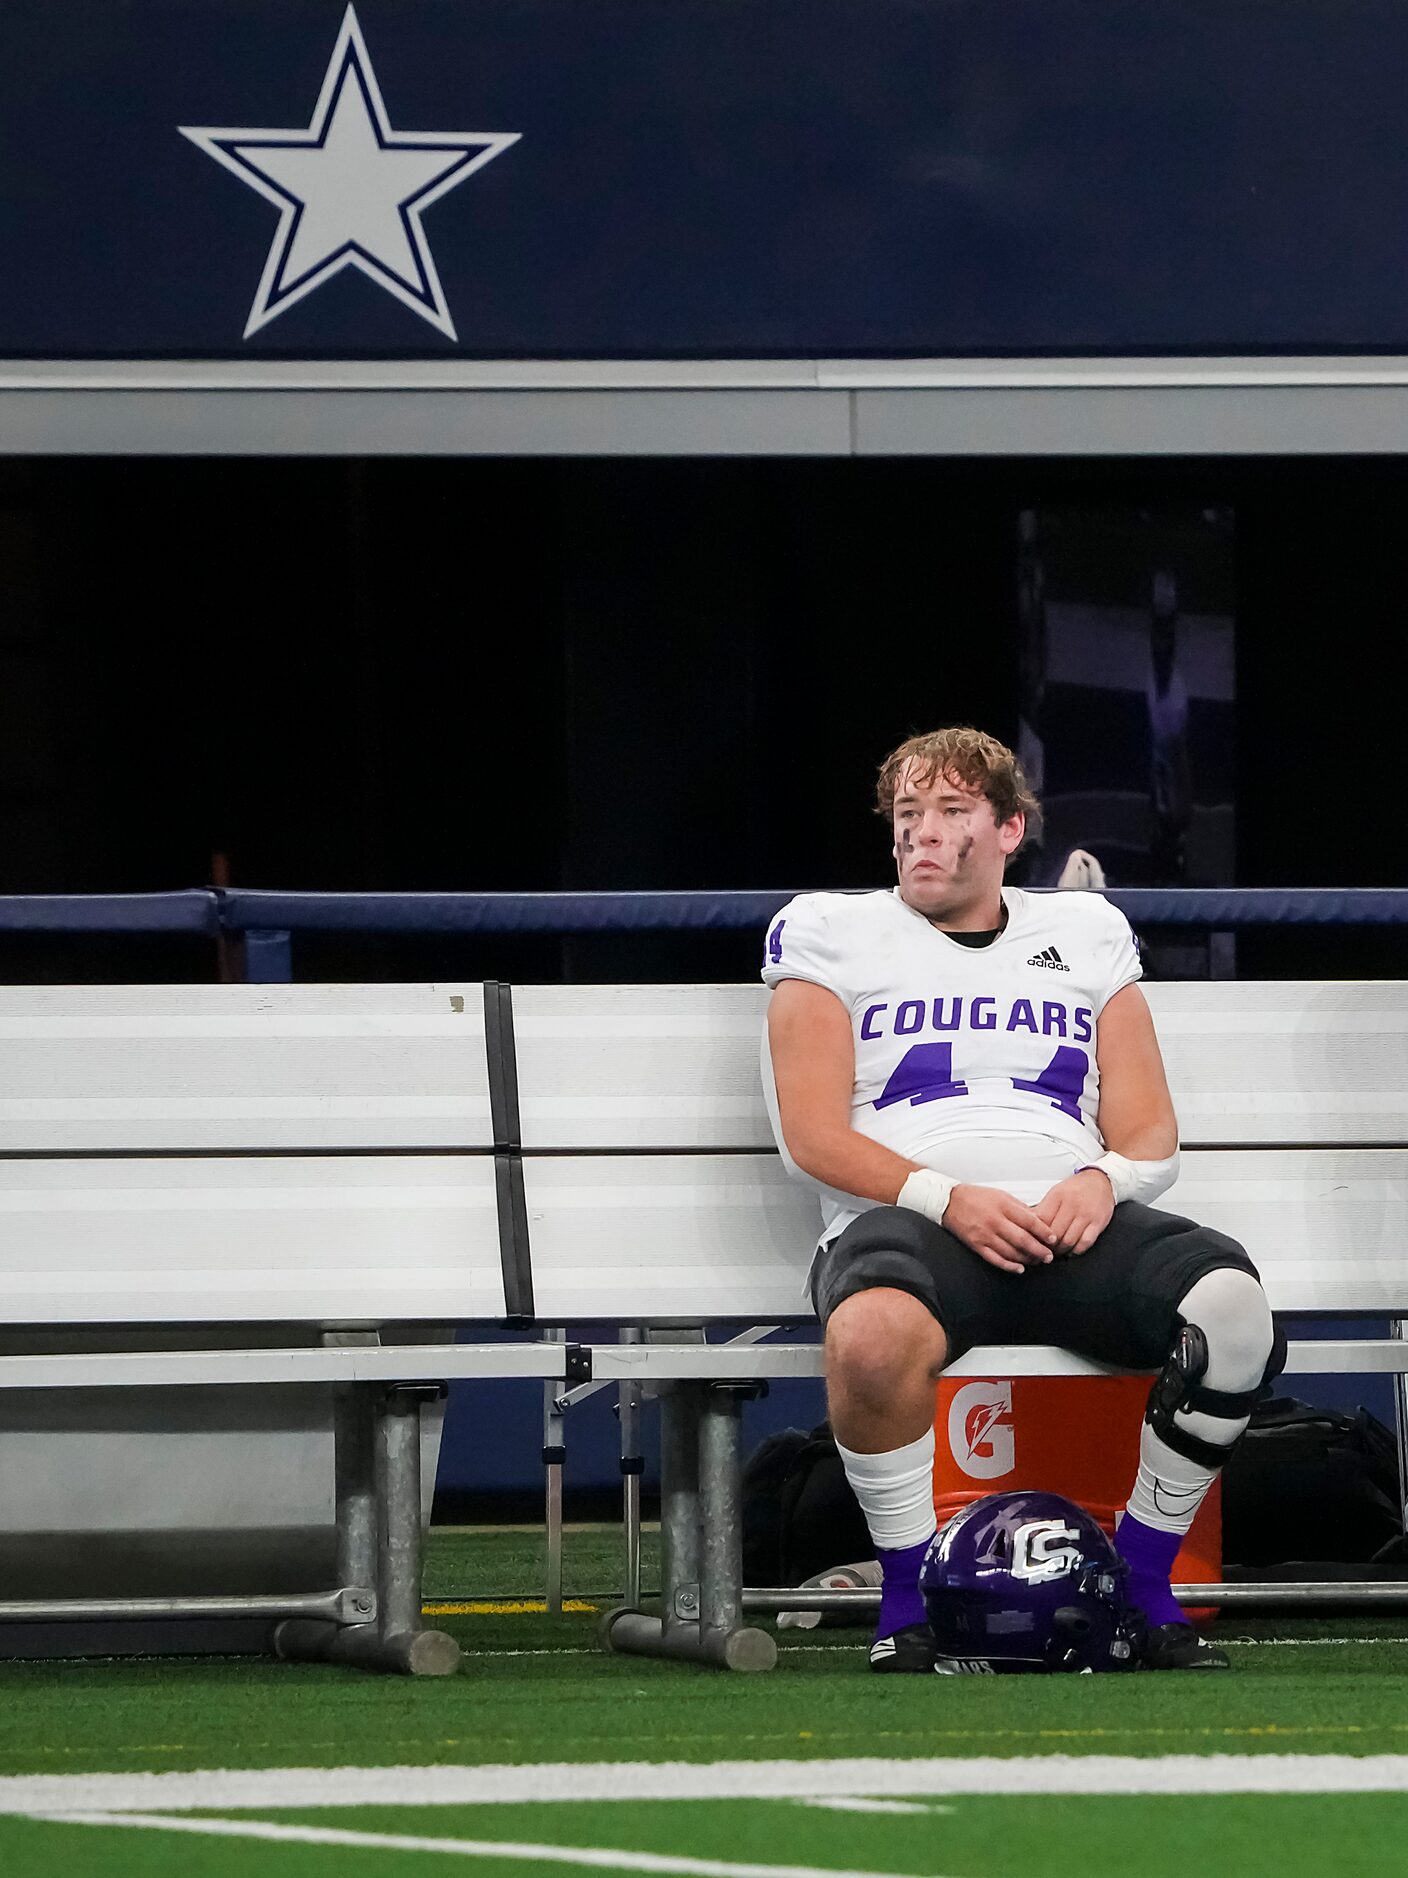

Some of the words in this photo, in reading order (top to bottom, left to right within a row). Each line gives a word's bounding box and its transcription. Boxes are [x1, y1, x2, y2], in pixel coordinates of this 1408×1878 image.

[763, 919, 786, 967] 4
[1026, 959, 1071, 972] adidas
[861, 996, 1092, 1042] COUGARS
[872, 1041, 1089, 1126] 44
[947, 1380, 1015, 1479] G
[1011, 1519, 1081, 1586] CS
